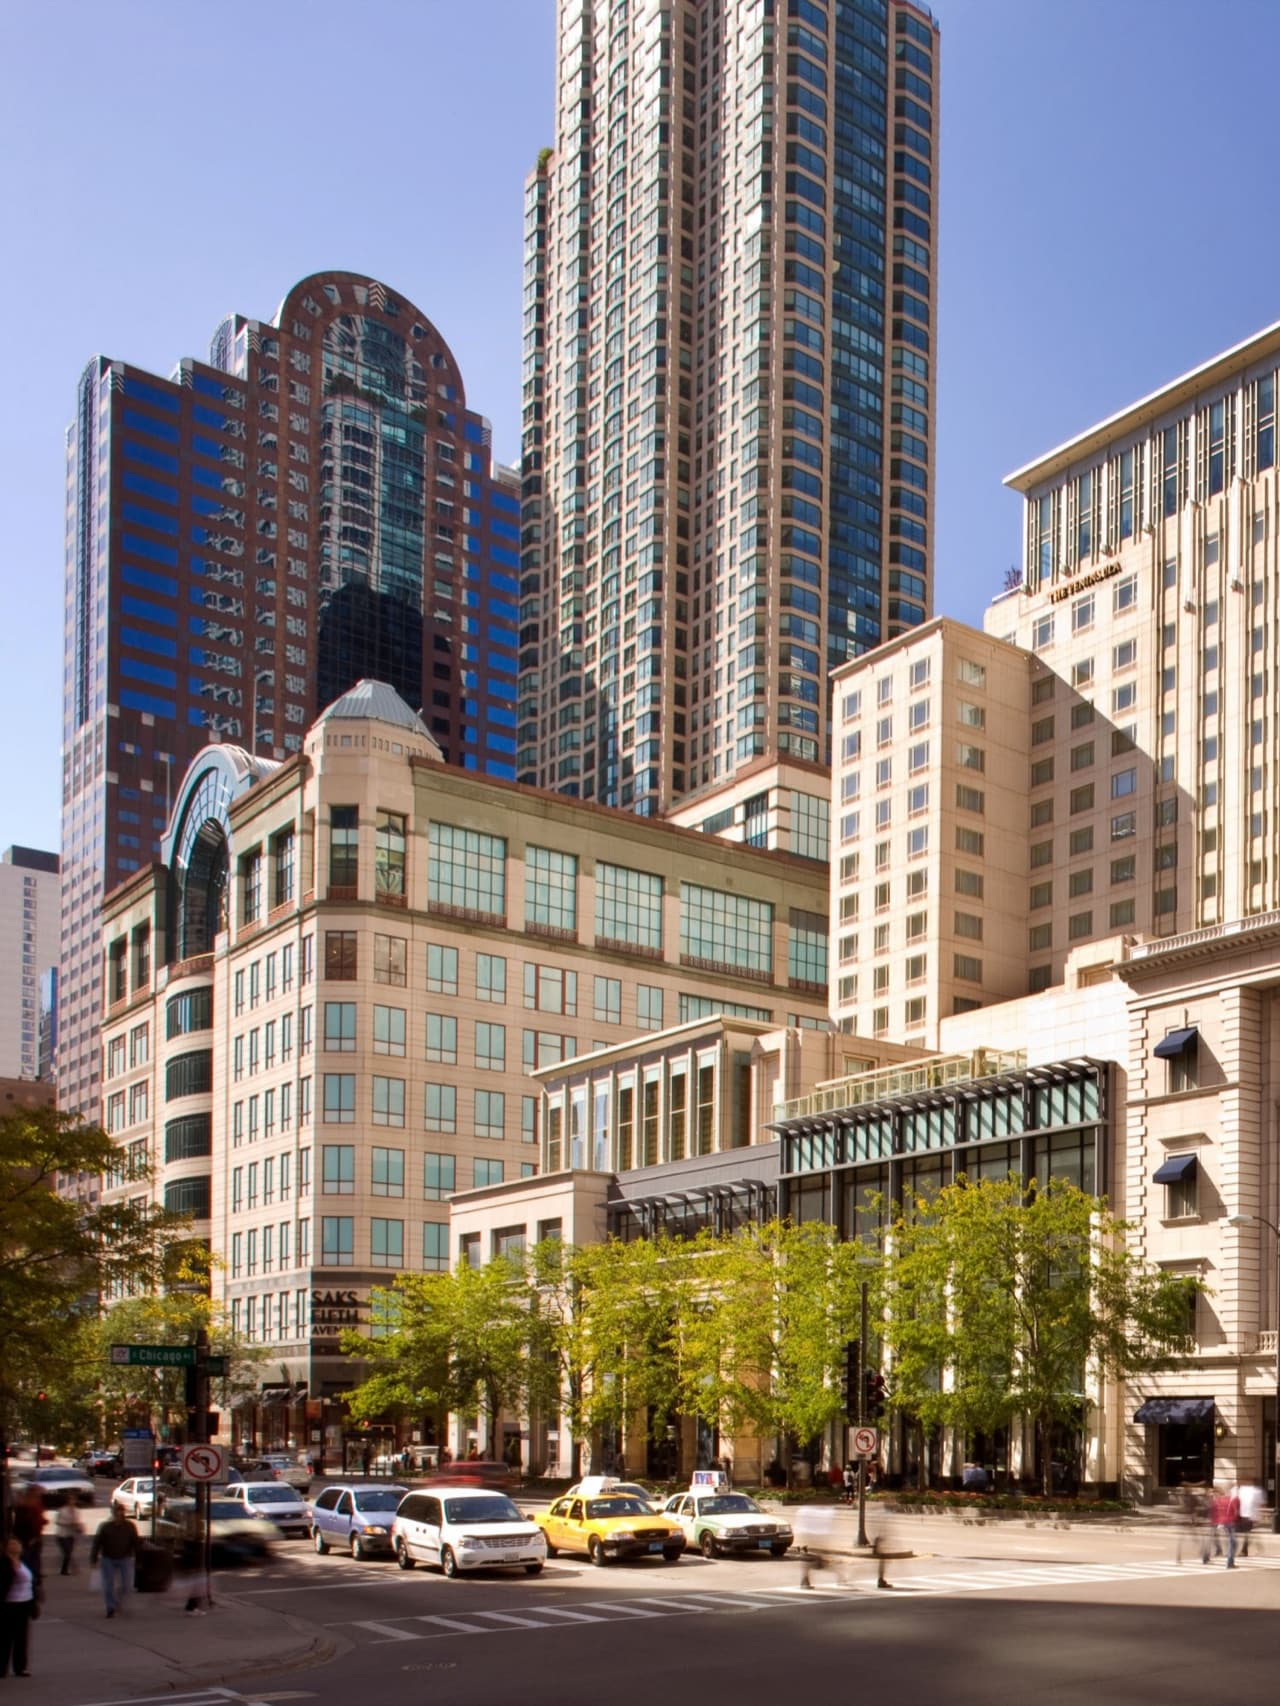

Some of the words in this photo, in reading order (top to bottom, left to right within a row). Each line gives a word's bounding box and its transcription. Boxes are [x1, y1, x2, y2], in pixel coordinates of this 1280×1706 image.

[312, 1290, 358, 1306] SAKS
[312, 1309, 359, 1323] FIFTH
[312, 1325, 358, 1336] AVEN
[139, 1348, 182, 1364] Chicago
